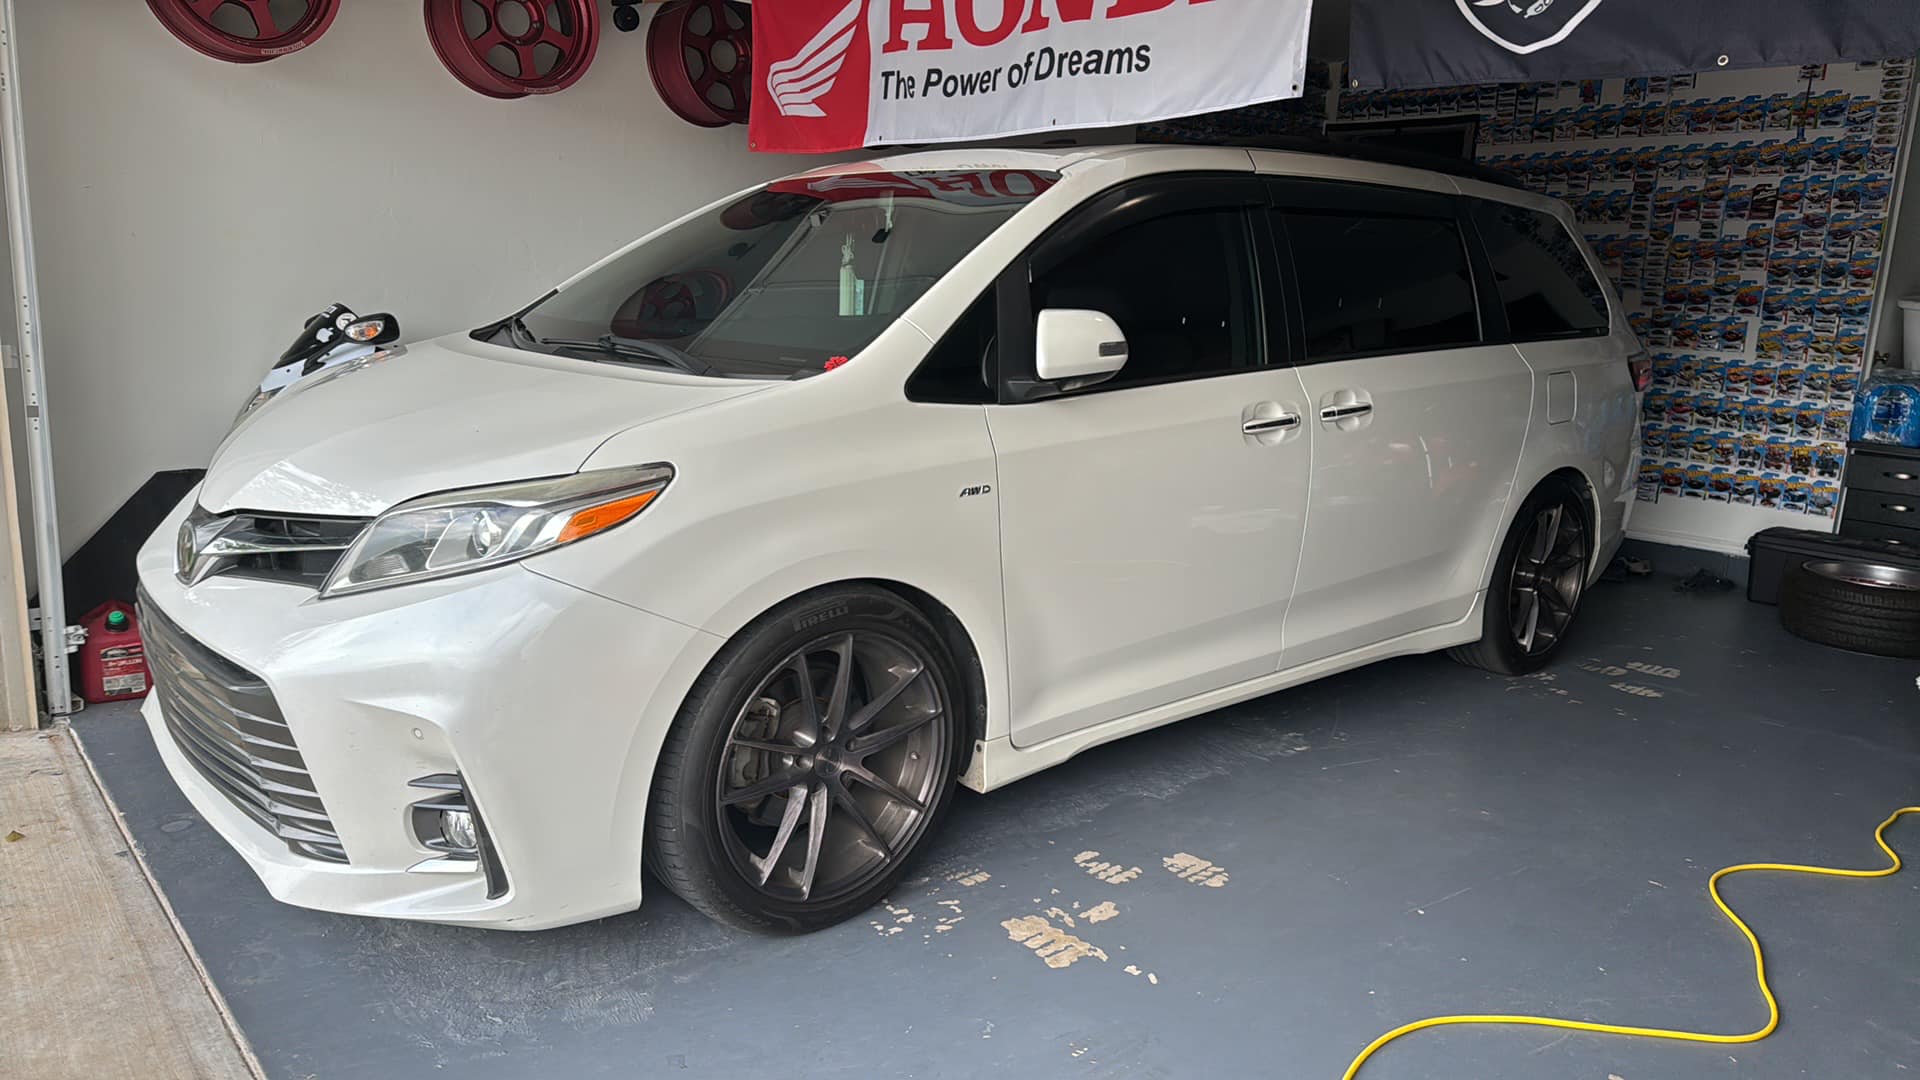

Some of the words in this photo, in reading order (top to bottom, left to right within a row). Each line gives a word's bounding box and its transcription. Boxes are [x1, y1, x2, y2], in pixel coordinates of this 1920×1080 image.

[881, 71, 915, 100] The
[921, 68, 1001, 98] Power
[1007, 52, 1034, 89] of
[1034, 44, 1151, 81] Dreams
[959, 484, 991, 497] AWD
[792, 600, 849, 632] PIRELLI
